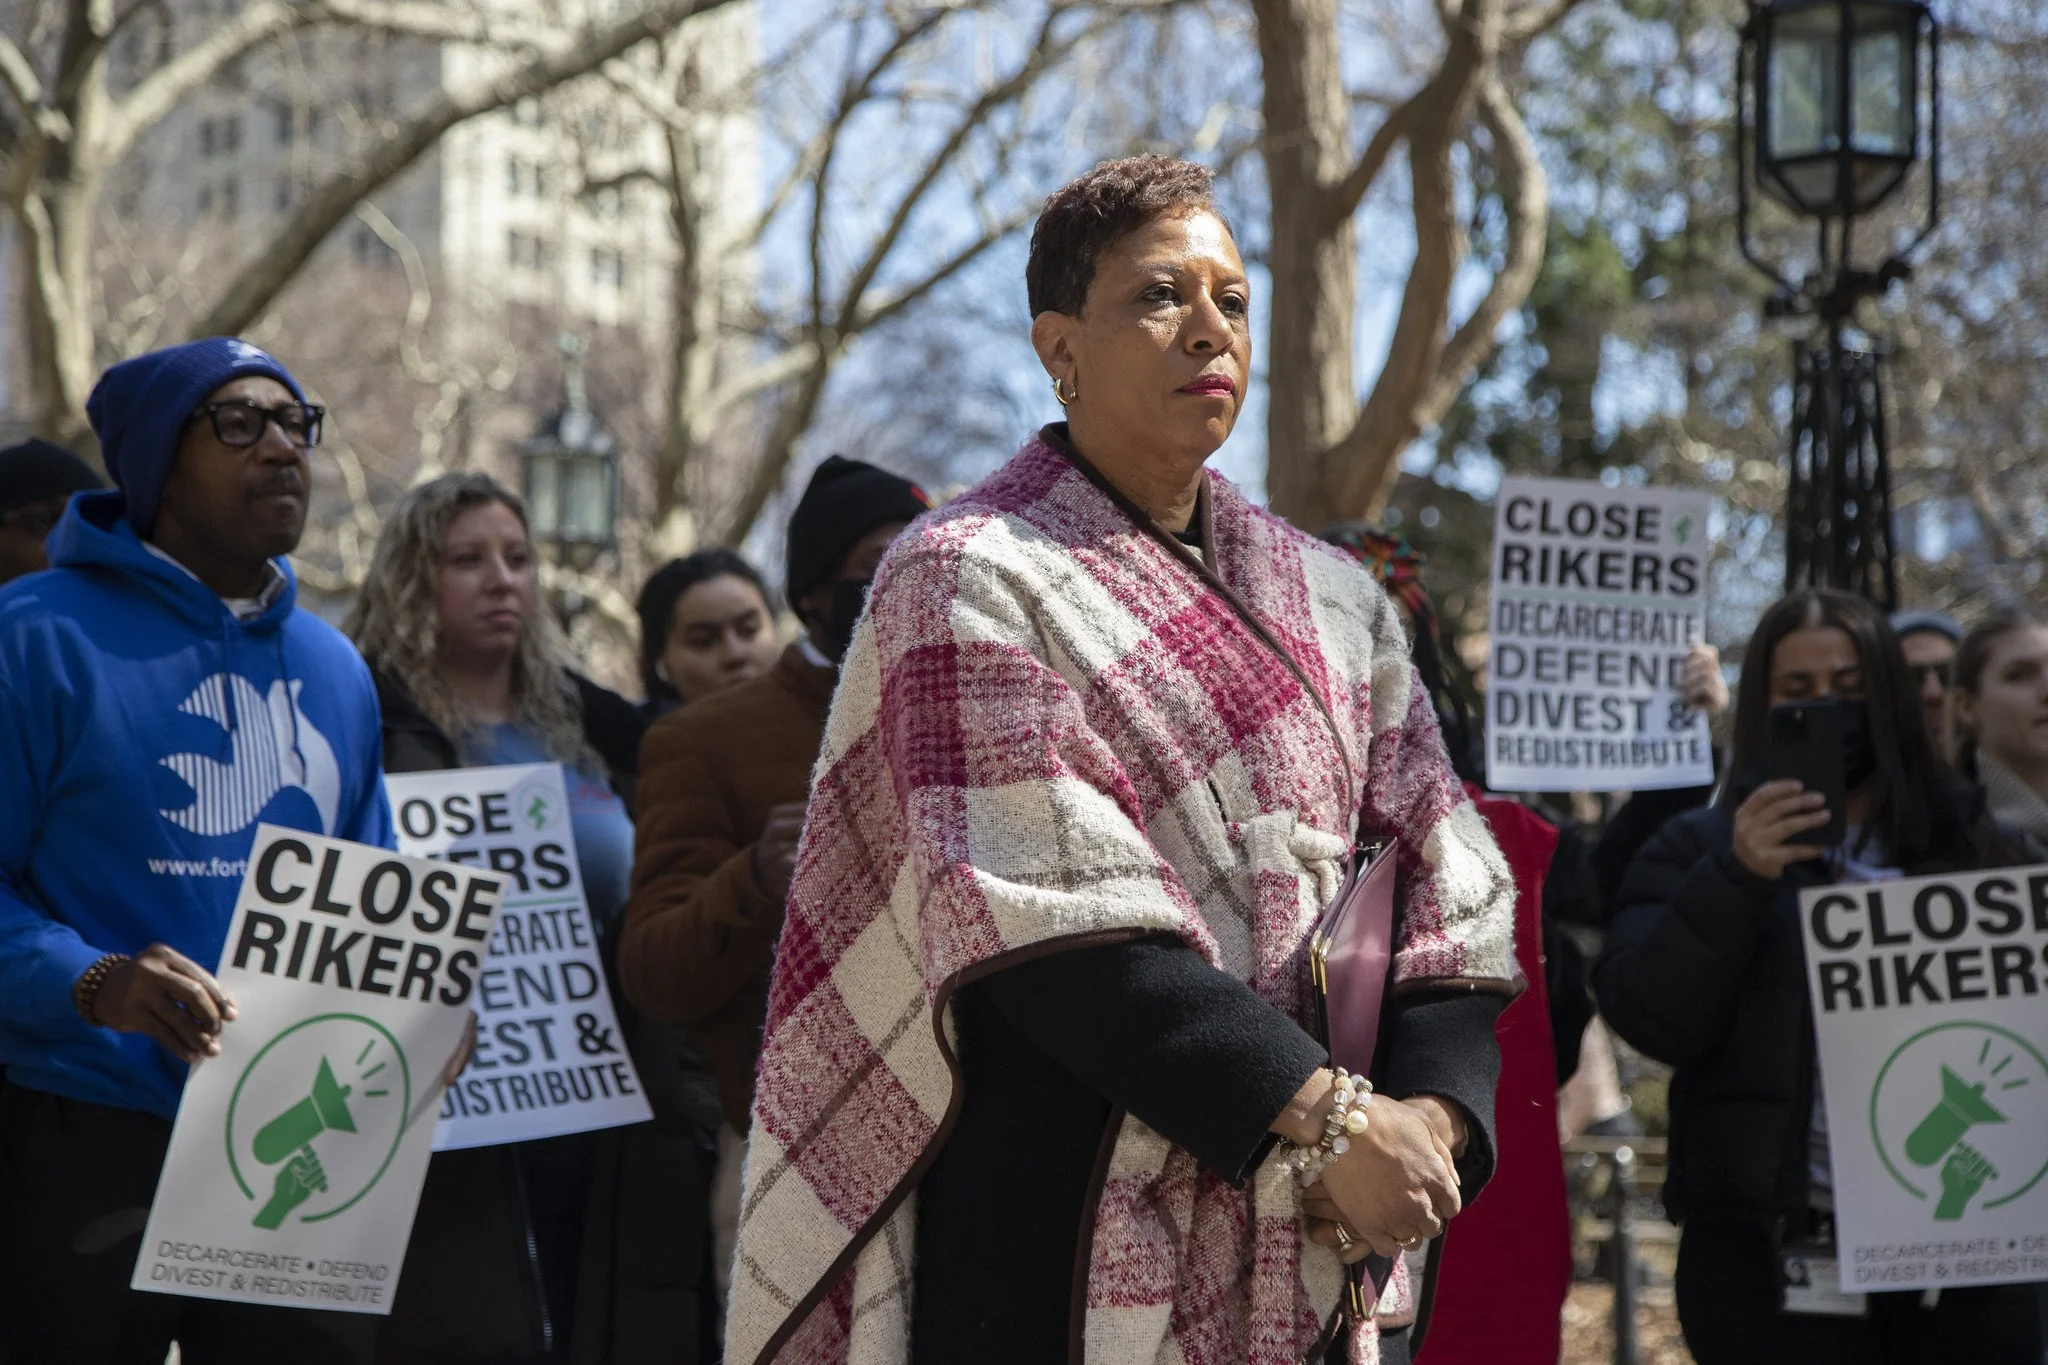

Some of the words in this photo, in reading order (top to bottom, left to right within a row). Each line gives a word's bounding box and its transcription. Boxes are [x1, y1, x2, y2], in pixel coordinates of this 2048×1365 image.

[1505, 495, 1661, 544] CLOSE
[1500, 545, 1698, 597] RIKERS
[1496, 601, 1697, 645] DECARCERATE
[1496, 691, 1653, 733] DIVEST
[1667, 700, 1699, 733] &
[1496, 736, 1701, 768] REDISTRIBUTE
[396, 793, 513, 840] OSE
[255, 838, 501, 942] CLOSE
[231, 909, 478, 1007] RIKERS
[1818, 941, 2048, 1014] RIKER
[574, 1012, 620, 1057] &
[156, 1239, 302, 1274] DECARCERATE
[317, 1258, 390, 1282] DEFEND
[1854, 1236, 2001, 1264] DECARCERATE
[149, 1262, 229, 1289] DIVEST
[229, 1273, 248, 1292] &
[251, 1275, 384, 1305] REDISTRIBUTE
[1854, 1261, 1927, 1284] DIVEST
[1933, 1262, 1949, 1280] &
